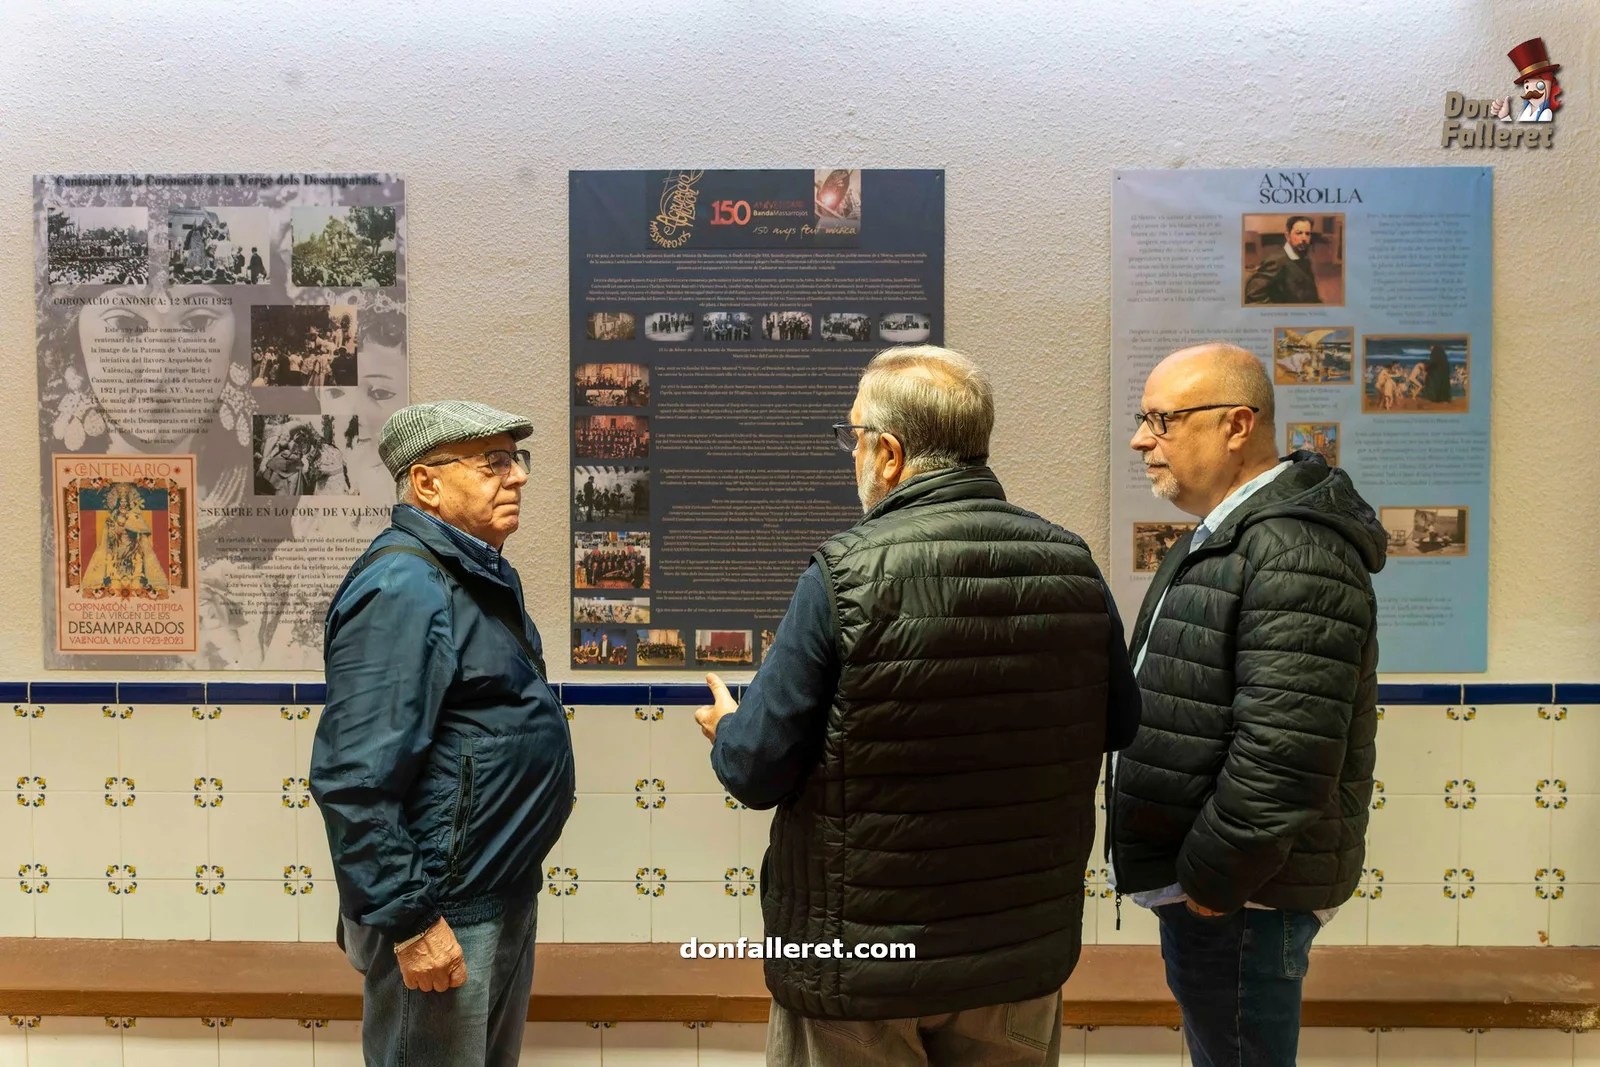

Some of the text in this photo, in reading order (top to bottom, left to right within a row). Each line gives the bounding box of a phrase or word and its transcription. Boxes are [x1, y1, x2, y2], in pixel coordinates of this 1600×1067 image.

[56, 174, 381, 188] Centenari de la Coronació de la Verge dels Desemparats.
[1260, 188, 1363, 204] SOROLLA
[710, 200, 751, 225] 150
[752, 226, 769, 235] 150
[54, 296, 232, 306] CORONACIÓ CANÒNICA: 12 MAIG 1923
[74, 463, 171, 476] CENTENARIO
[256, 508, 270, 517] EN
[274, 508, 288, 517] LO
[323, 508, 338, 517] DE
[342, 506, 391, 517] VALÈNCI
[82, 612, 93, 620] DE
[96, 612, 106, 620] LA
[110, 612, 141, 620] VIRGEN
[144, 612, 156, 620] DE
[68, 621, 185, 634] DESAMPARADOS
[113, 636, 140, 645] MAYO
[142, 636, 184, 645] 1923-2023
